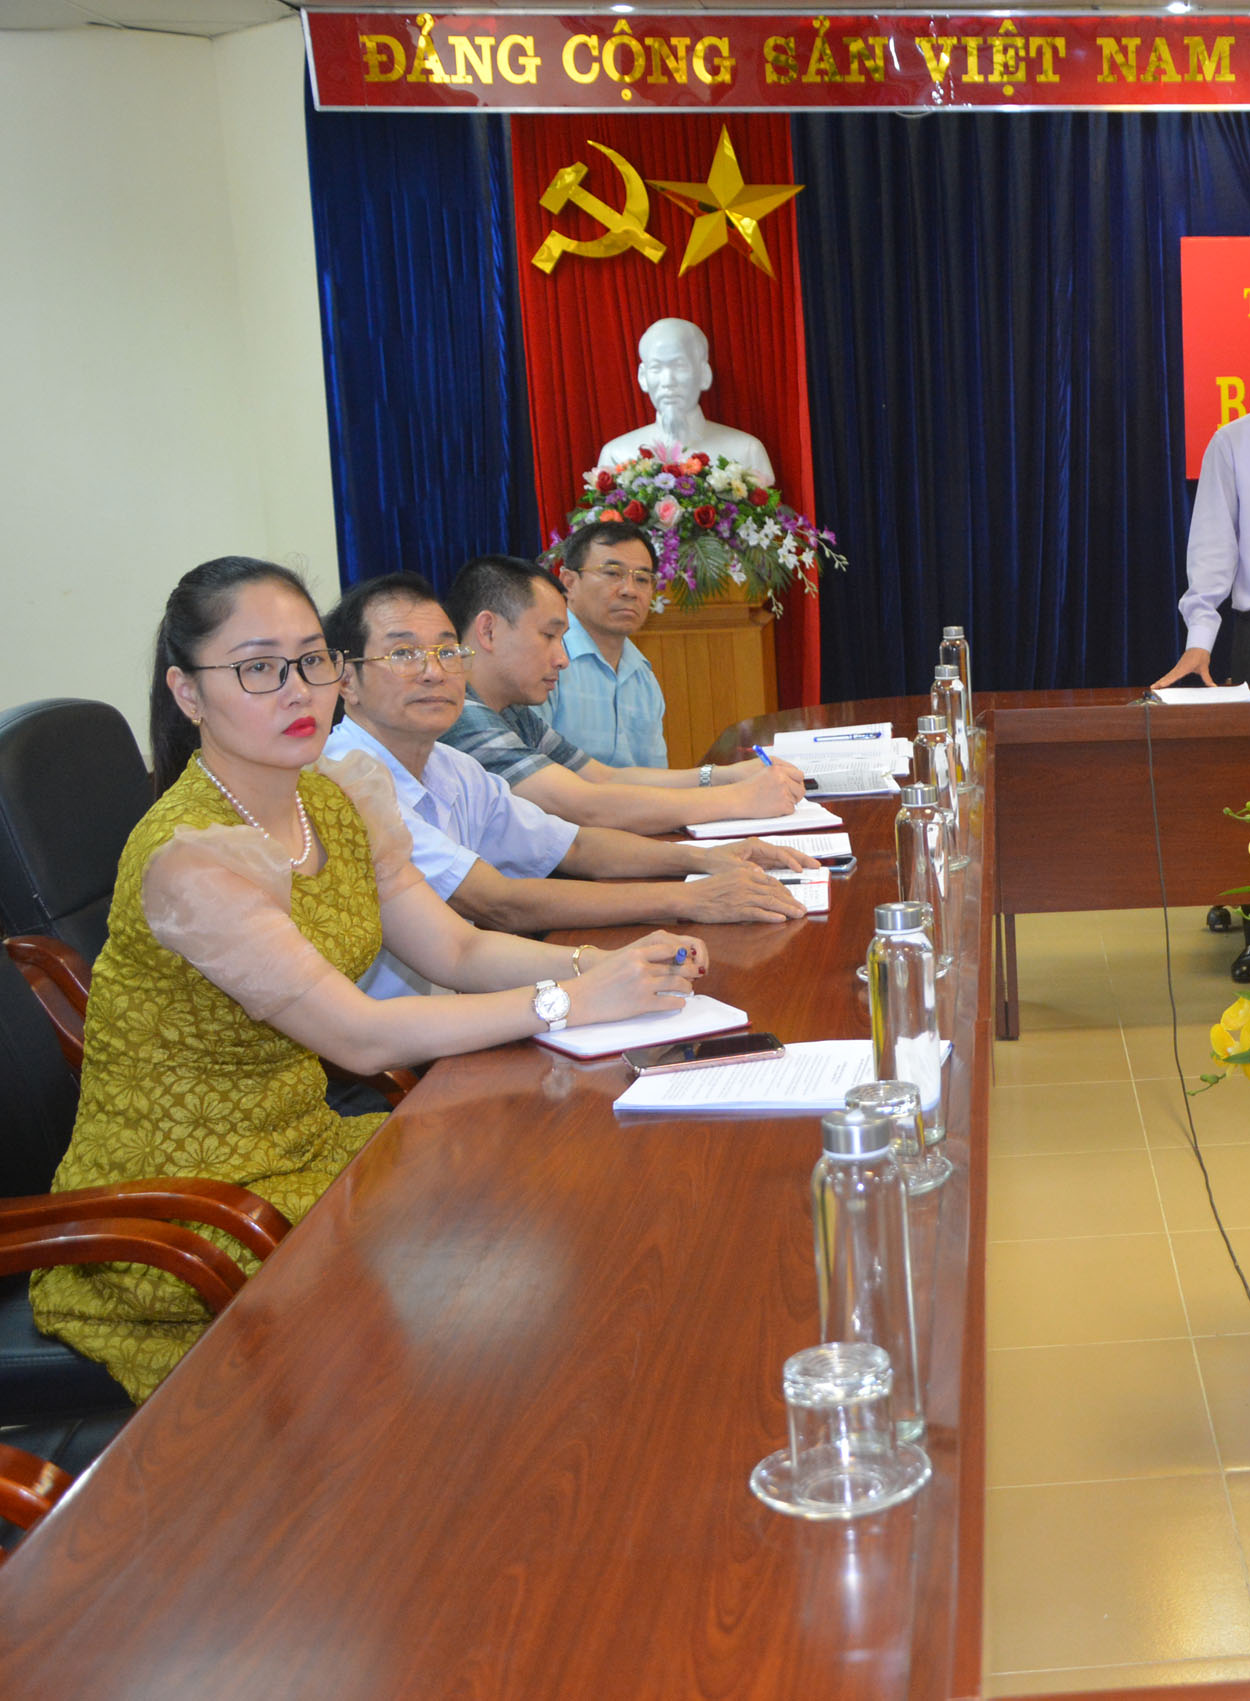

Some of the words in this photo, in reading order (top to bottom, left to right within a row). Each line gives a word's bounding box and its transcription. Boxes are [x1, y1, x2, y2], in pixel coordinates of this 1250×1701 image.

[359, 12, 541, 84] ĐẢNG
[562, 18, 736, 101] CỘNG
[763, 15, 888, 85] SẢN
[915, 18, 1066, 97] VIỆT
[1096, 36, 1236, 84] NAM
